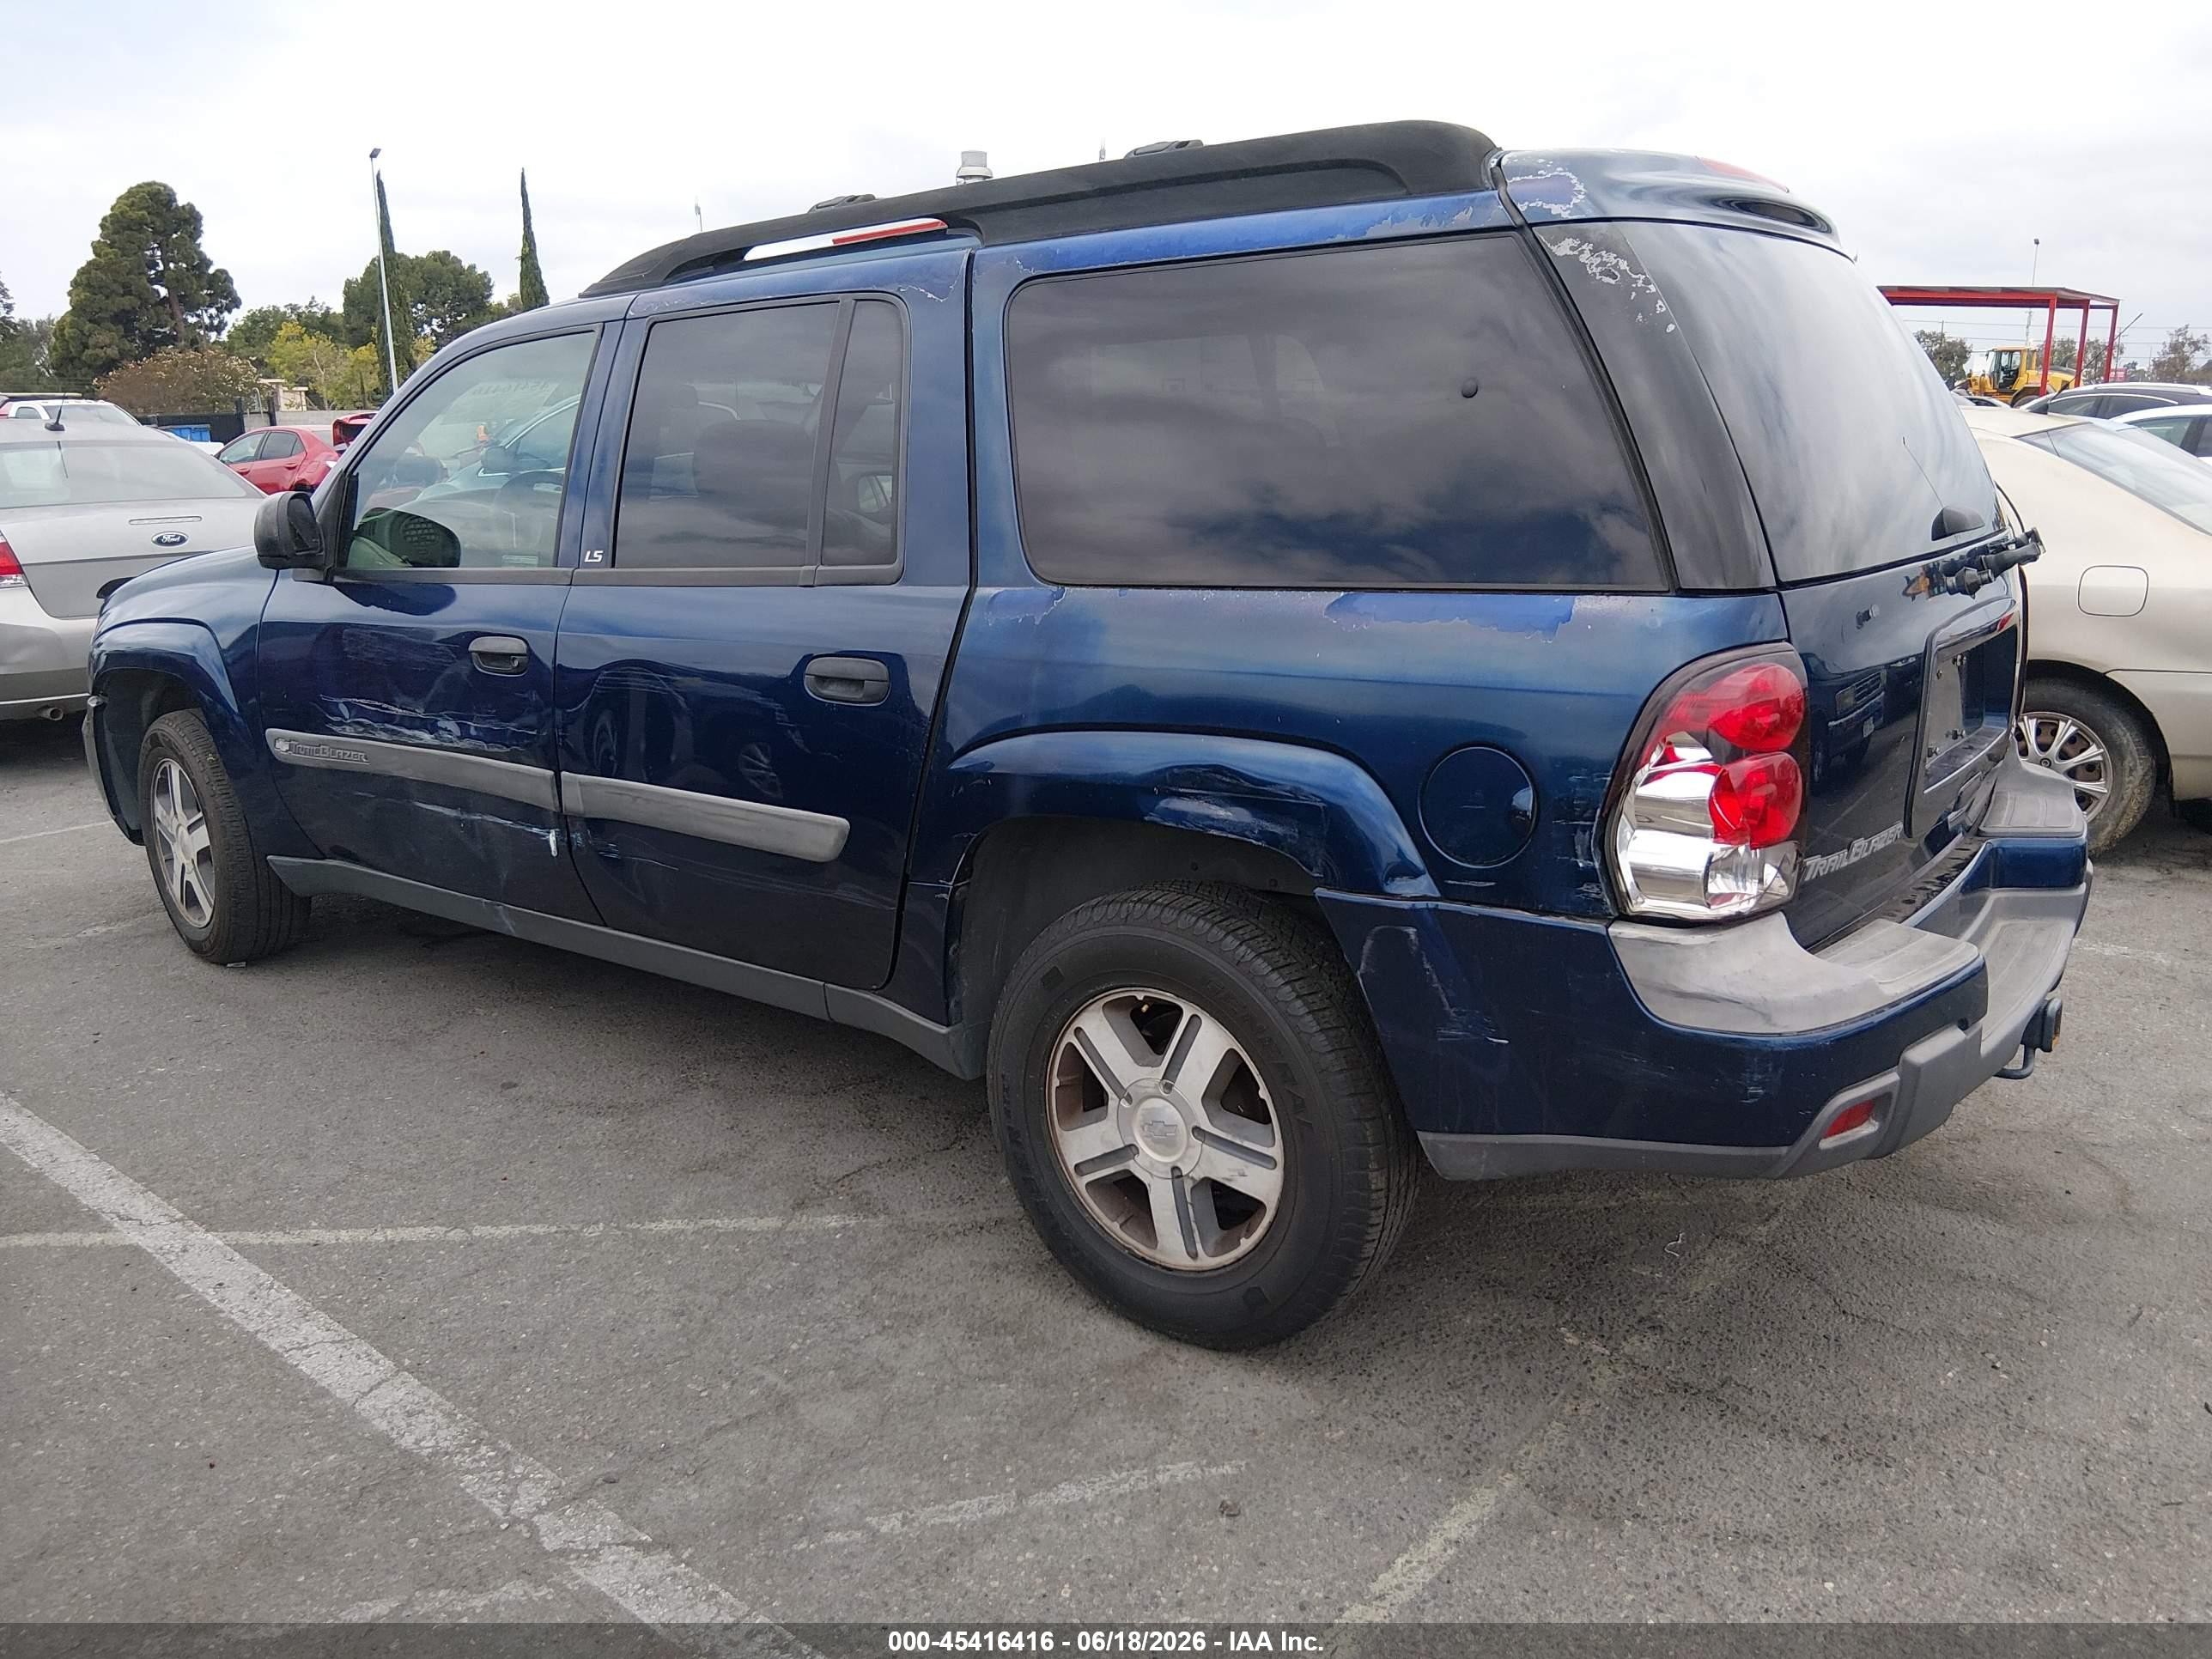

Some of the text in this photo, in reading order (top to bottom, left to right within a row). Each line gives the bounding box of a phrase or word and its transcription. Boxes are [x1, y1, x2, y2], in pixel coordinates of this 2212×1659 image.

[161, 534, 181, 544] Ford
[584, 550, 604, 562] LS
[1803, 821, 1904, 882] TRAILBLAZER
